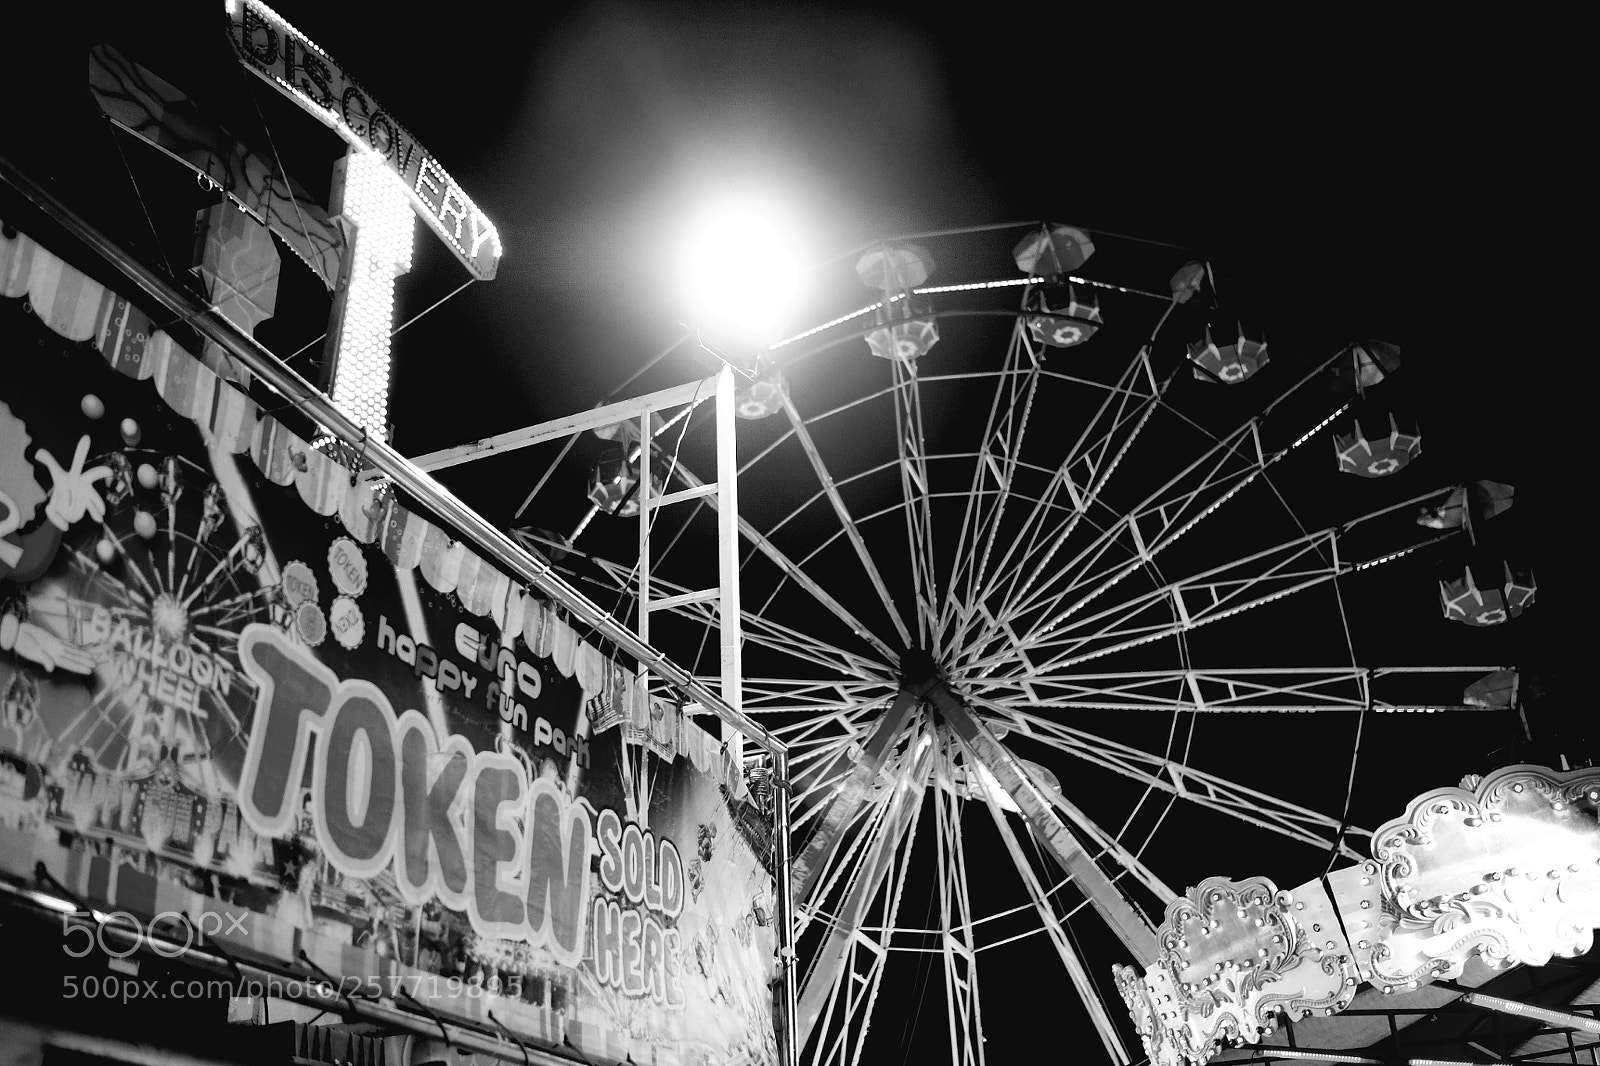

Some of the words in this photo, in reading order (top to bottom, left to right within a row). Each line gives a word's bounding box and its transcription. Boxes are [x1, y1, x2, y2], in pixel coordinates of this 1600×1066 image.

[242, 2, 492, 258] DISCOVERY
[333, 547, 364, 591] TOKEN
[88, 605, 233, 696] BALLOON
[97, 652, 210, 719] WHEEL
[485, 680, 529, 733] fun
[533, 715, 591, 769] park
[238, 622, 593, 969] TOKEN
[597, 808, 684, 922] SOLD
[593, 896, 686, 1011] HERE
